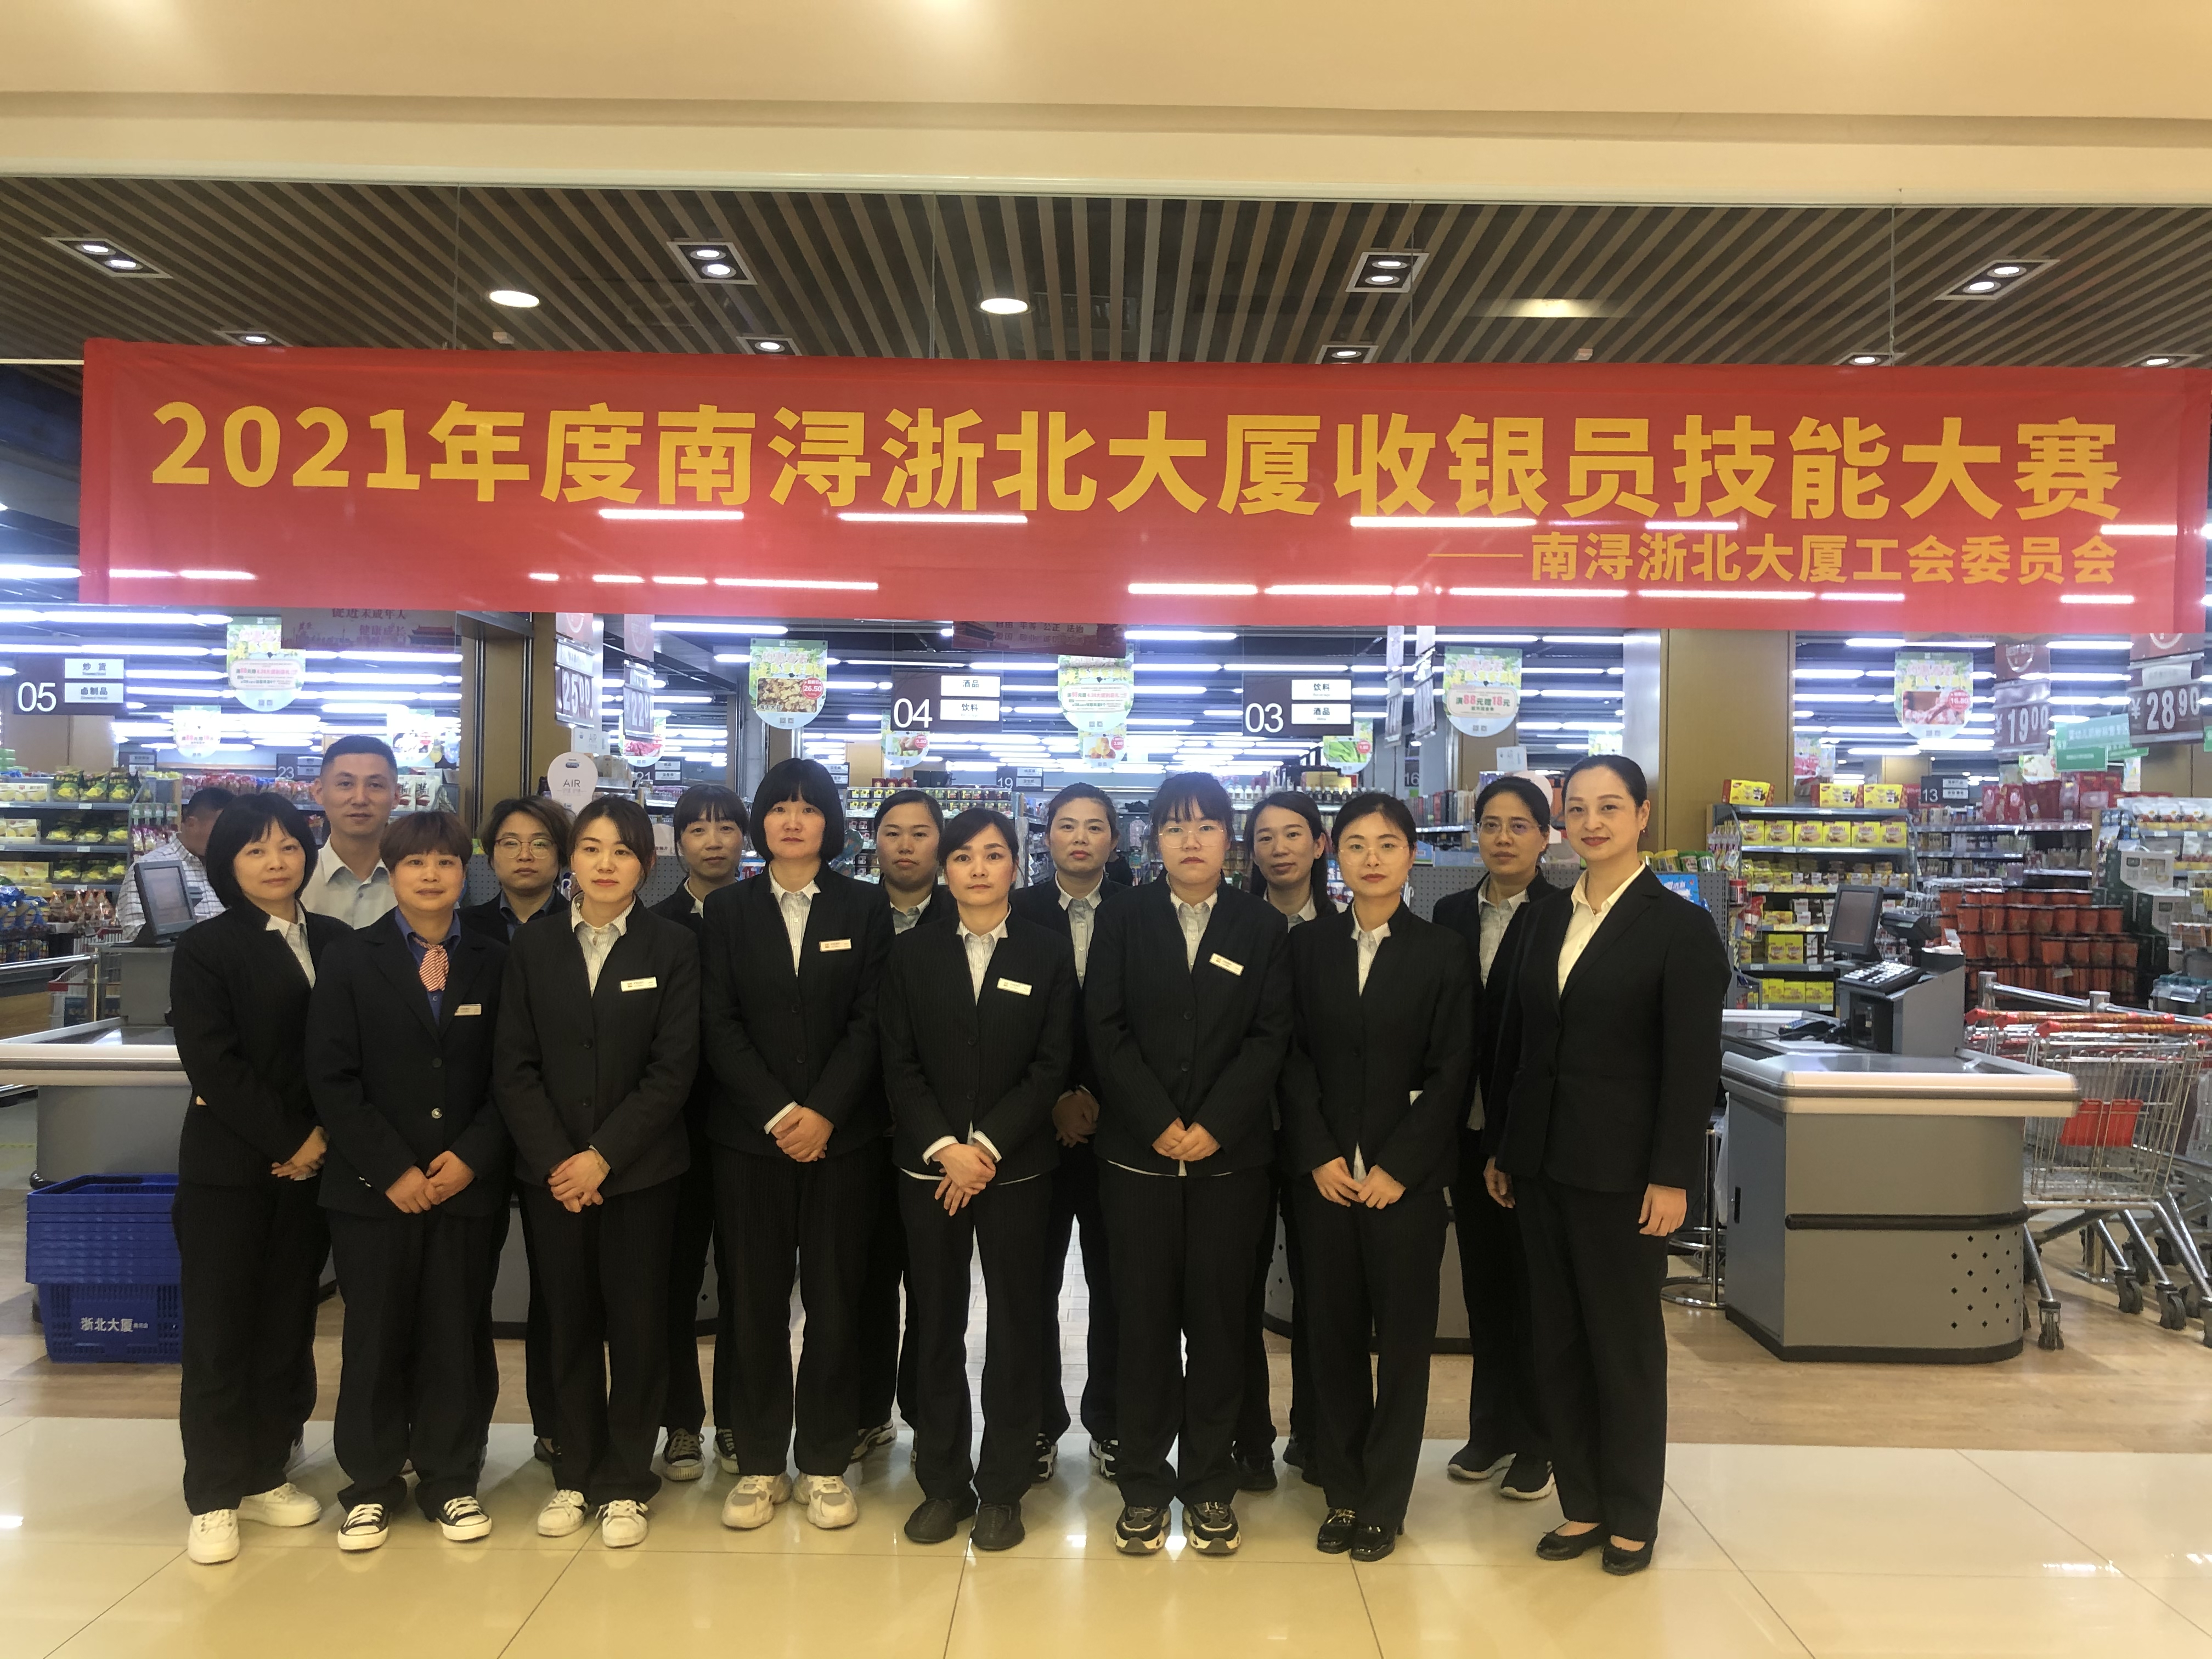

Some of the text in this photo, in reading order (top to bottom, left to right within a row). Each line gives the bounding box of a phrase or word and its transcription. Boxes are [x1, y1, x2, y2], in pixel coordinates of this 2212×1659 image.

[153, 401, 2120, 520] 2021年度南浔浙北大厦收银员技能大赛
[1043, 623, 1060, 631] 公正
[962, 680, 979, 688] 酒品
[1313, 683, 1330, 691] 饮料
[18, 681, 57, 712] 05
[893, 698, 933, 729] 04
[961, 703, 979, 712] 饮料
[1313, 707, 1330, 715] 酒品
[1245, 703, 1284, 733] 03
[278, 766, 295, 780] 23
[563, 779, 582, 788] AIR
[997, 777, 1013, 790] 19
[1922, 788, 1938, 803] 13
[80, 1317, 133, 1333] 浙北大厦
